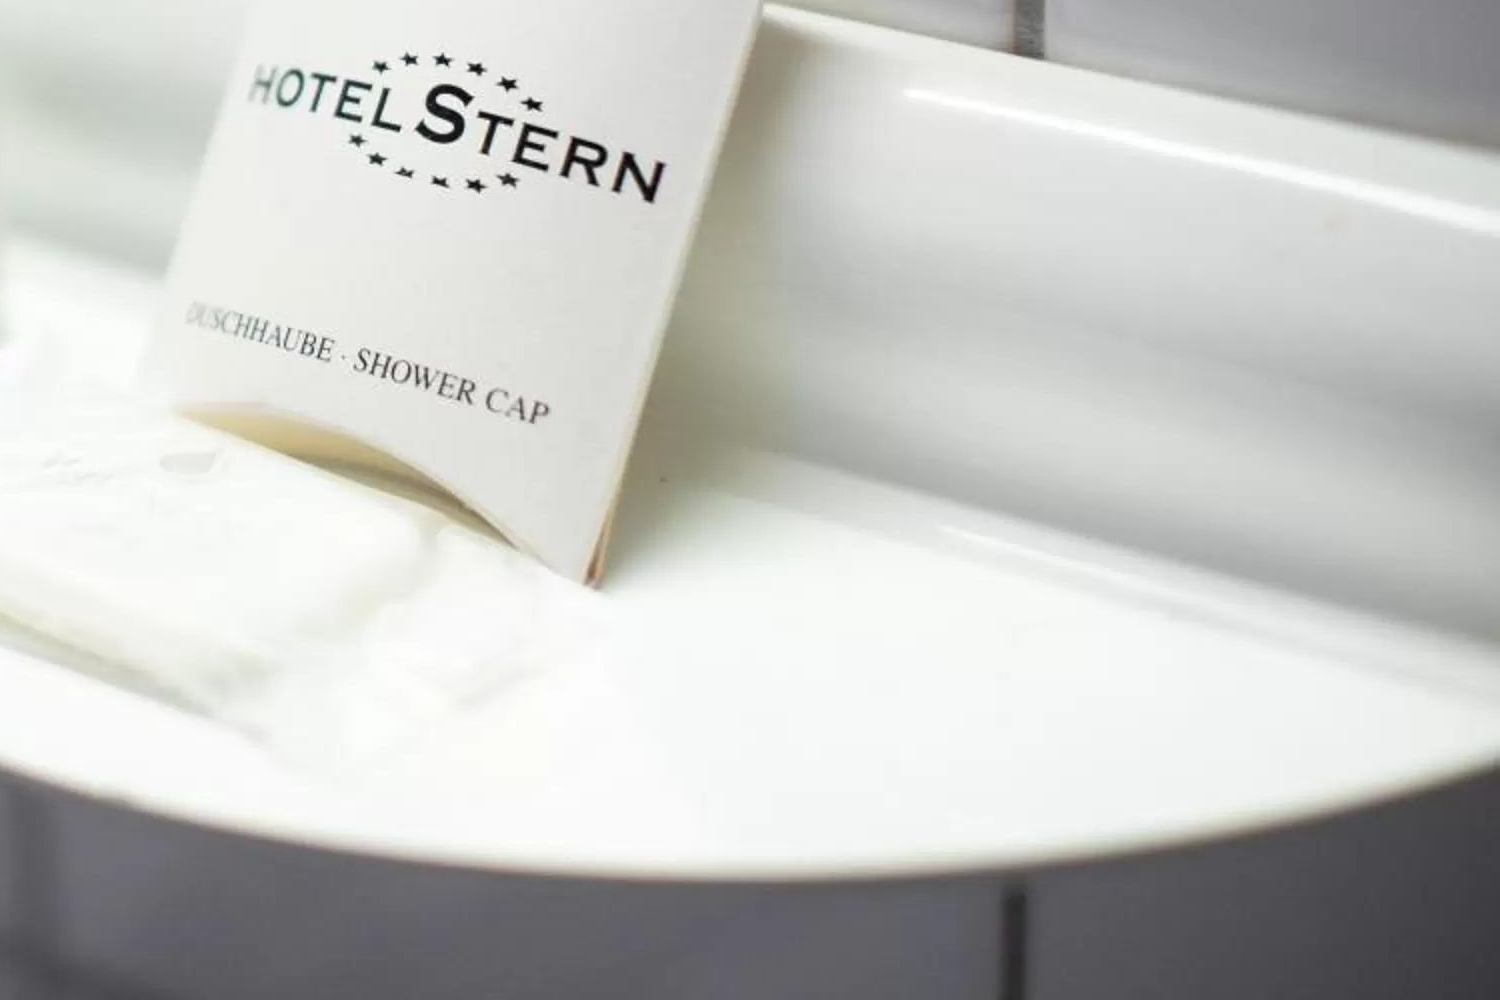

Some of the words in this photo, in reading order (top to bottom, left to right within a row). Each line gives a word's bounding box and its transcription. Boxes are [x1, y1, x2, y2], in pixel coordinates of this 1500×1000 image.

[248, 64, 401, 132] HOTEL
[415, 84, 667, 203] STERN
[185, 300, 336, 363] DUSCHHAUBE
[352, 347, 477, 405] SHOWER
[485, 387, 551, 425] CAP
